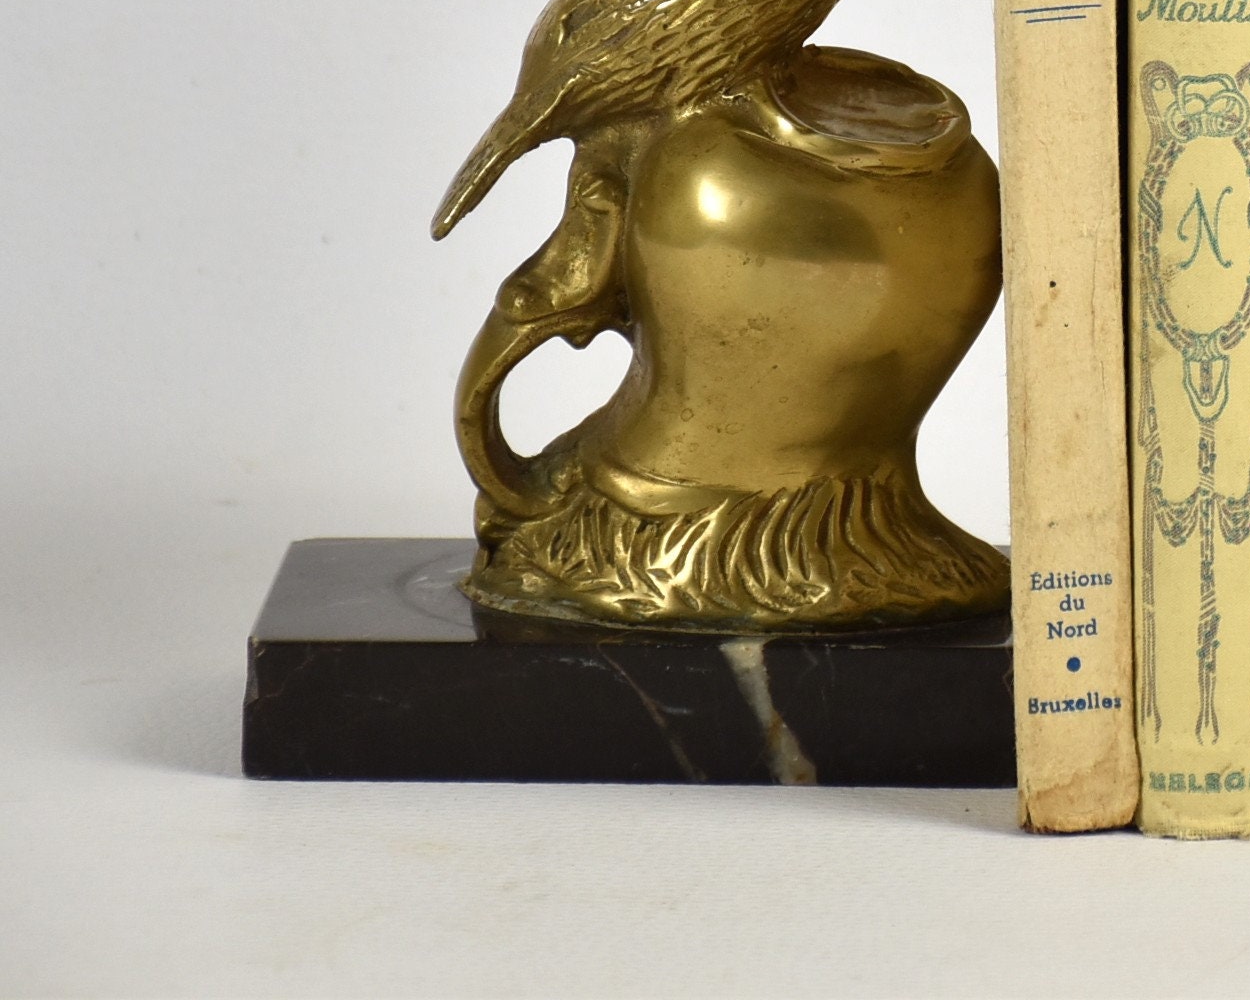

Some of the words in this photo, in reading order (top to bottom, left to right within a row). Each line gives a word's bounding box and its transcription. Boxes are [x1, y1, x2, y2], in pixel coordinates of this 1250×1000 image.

[1177, 186, 1233, 270] N
[1030, 571, 1113, 592] Éditions
[1059, 593, 1086, 612] du
[1047, 618, 1098, 640] Nord
[1028, 692, 1122, 715] Bruxelles
